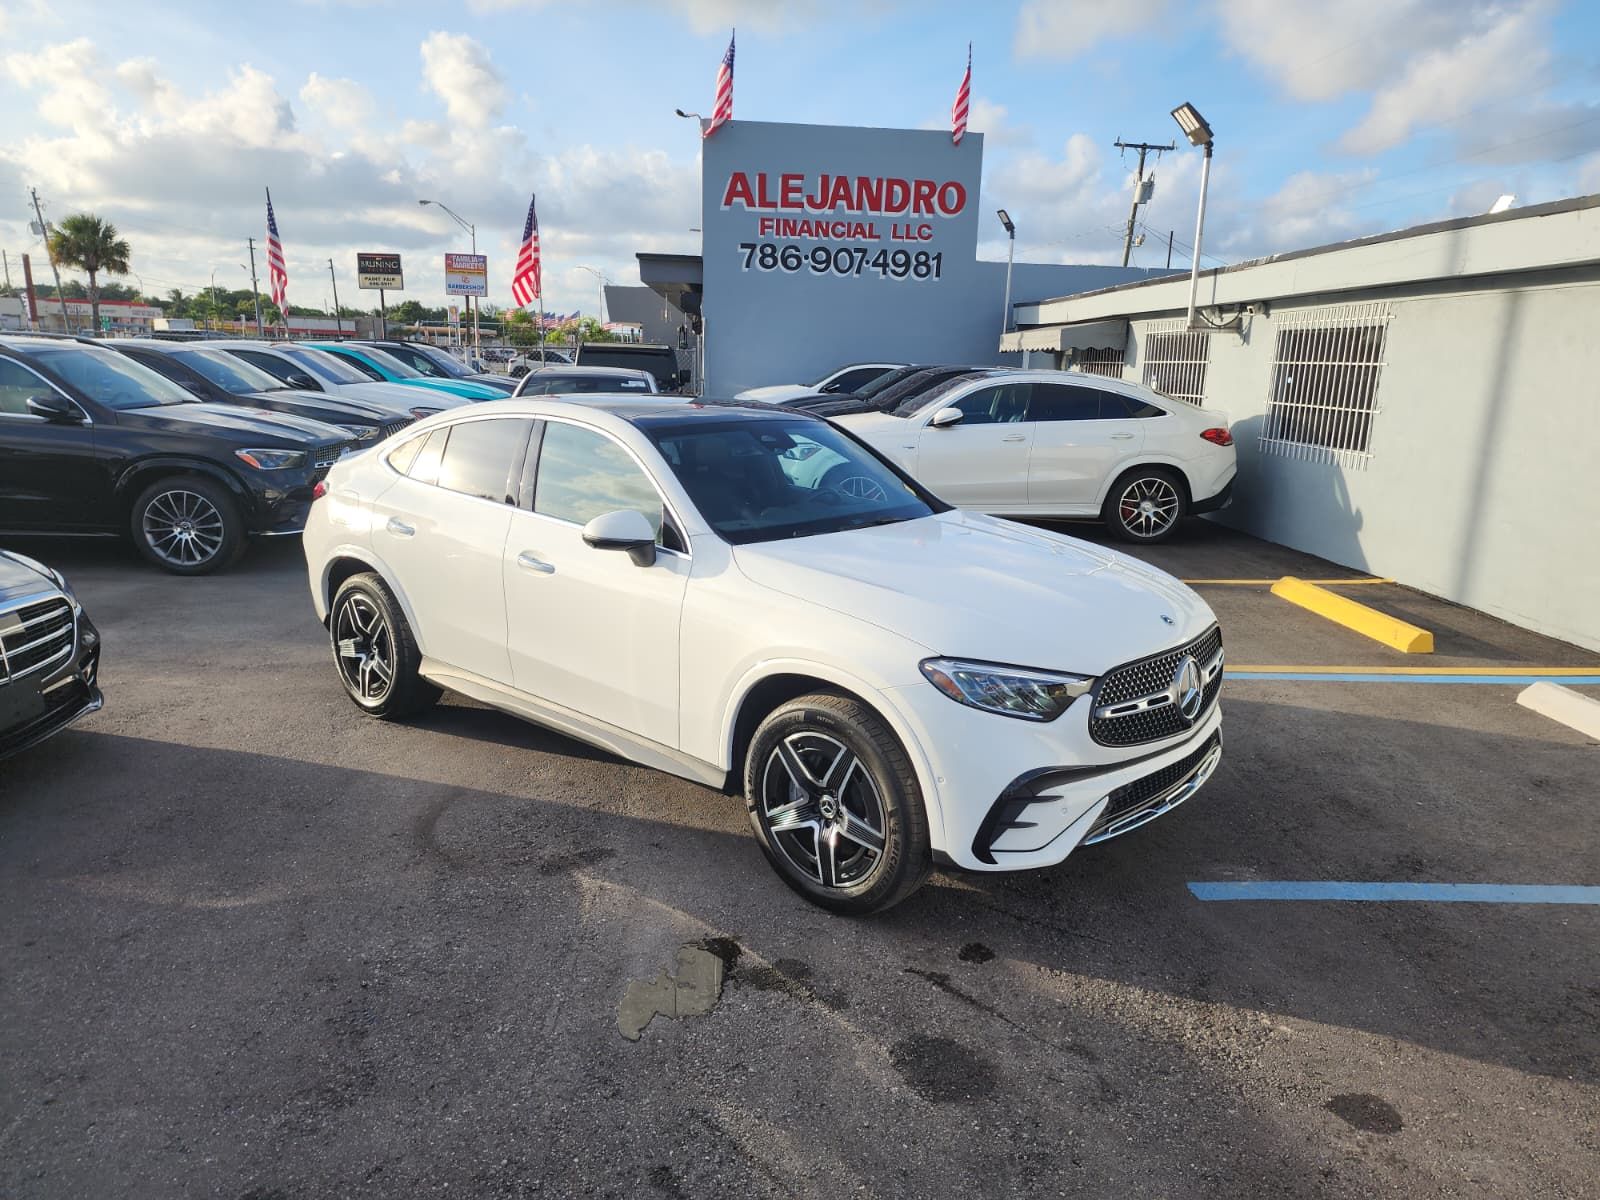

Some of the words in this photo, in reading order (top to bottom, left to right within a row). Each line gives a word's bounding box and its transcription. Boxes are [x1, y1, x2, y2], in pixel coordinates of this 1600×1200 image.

[720, 172, 966, 218] ALEJANDRO
[758, 217, 882, 241] FINANCIAL
[890, 222, 934, 242] LLC
